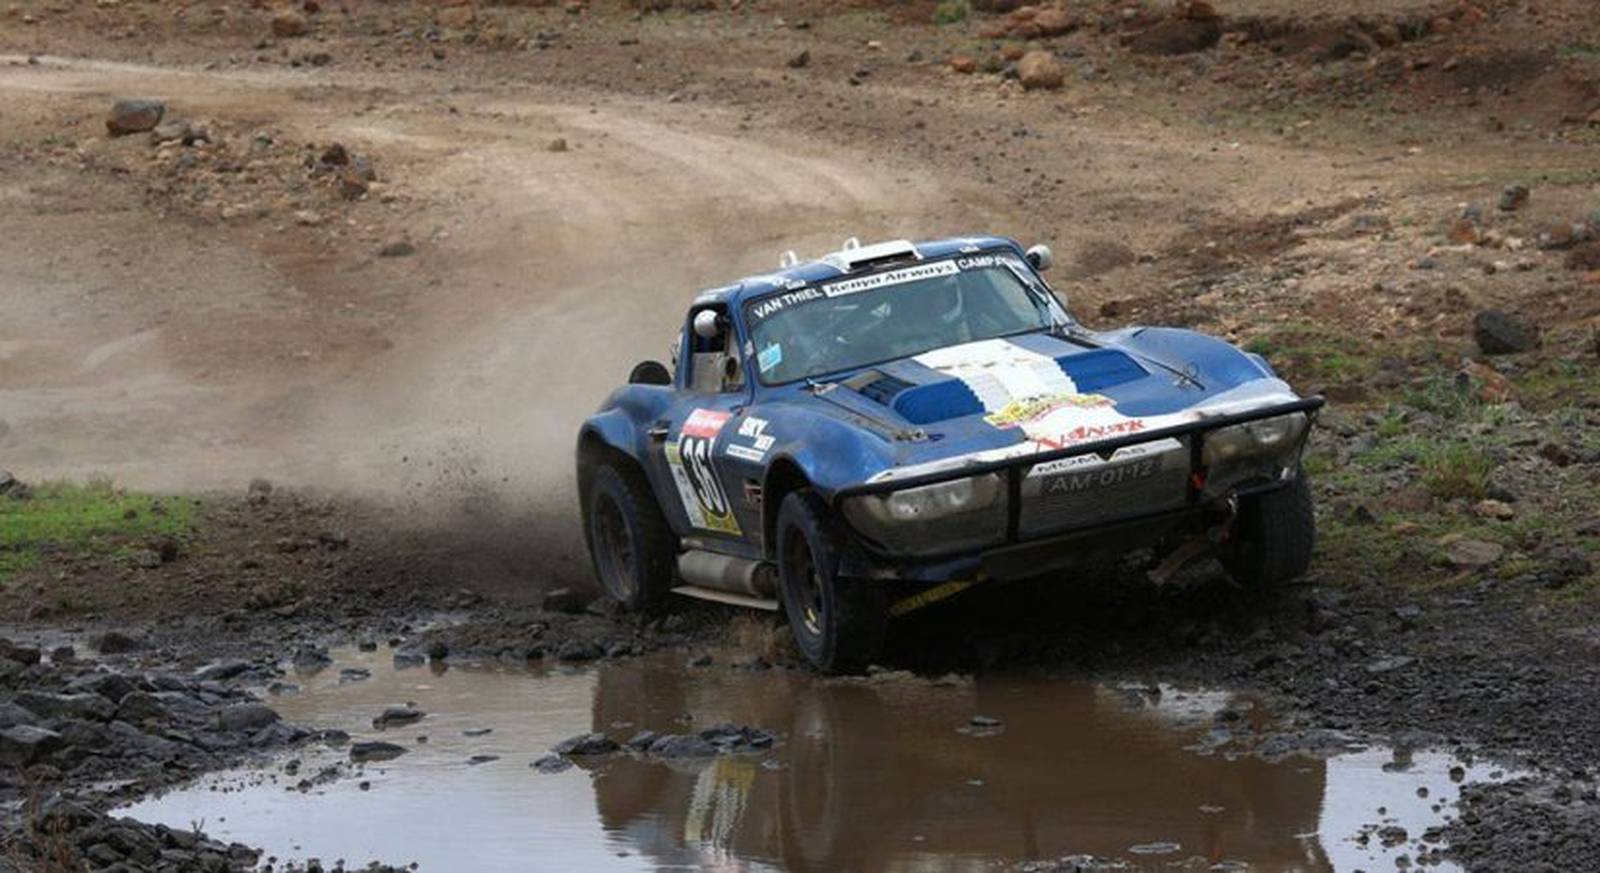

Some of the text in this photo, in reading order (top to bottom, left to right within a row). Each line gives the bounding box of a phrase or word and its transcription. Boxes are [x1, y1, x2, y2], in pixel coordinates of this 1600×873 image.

[829, 263, 953, 293] Kenya Airways
[753, 288, 823, 319] VAN THIEL
